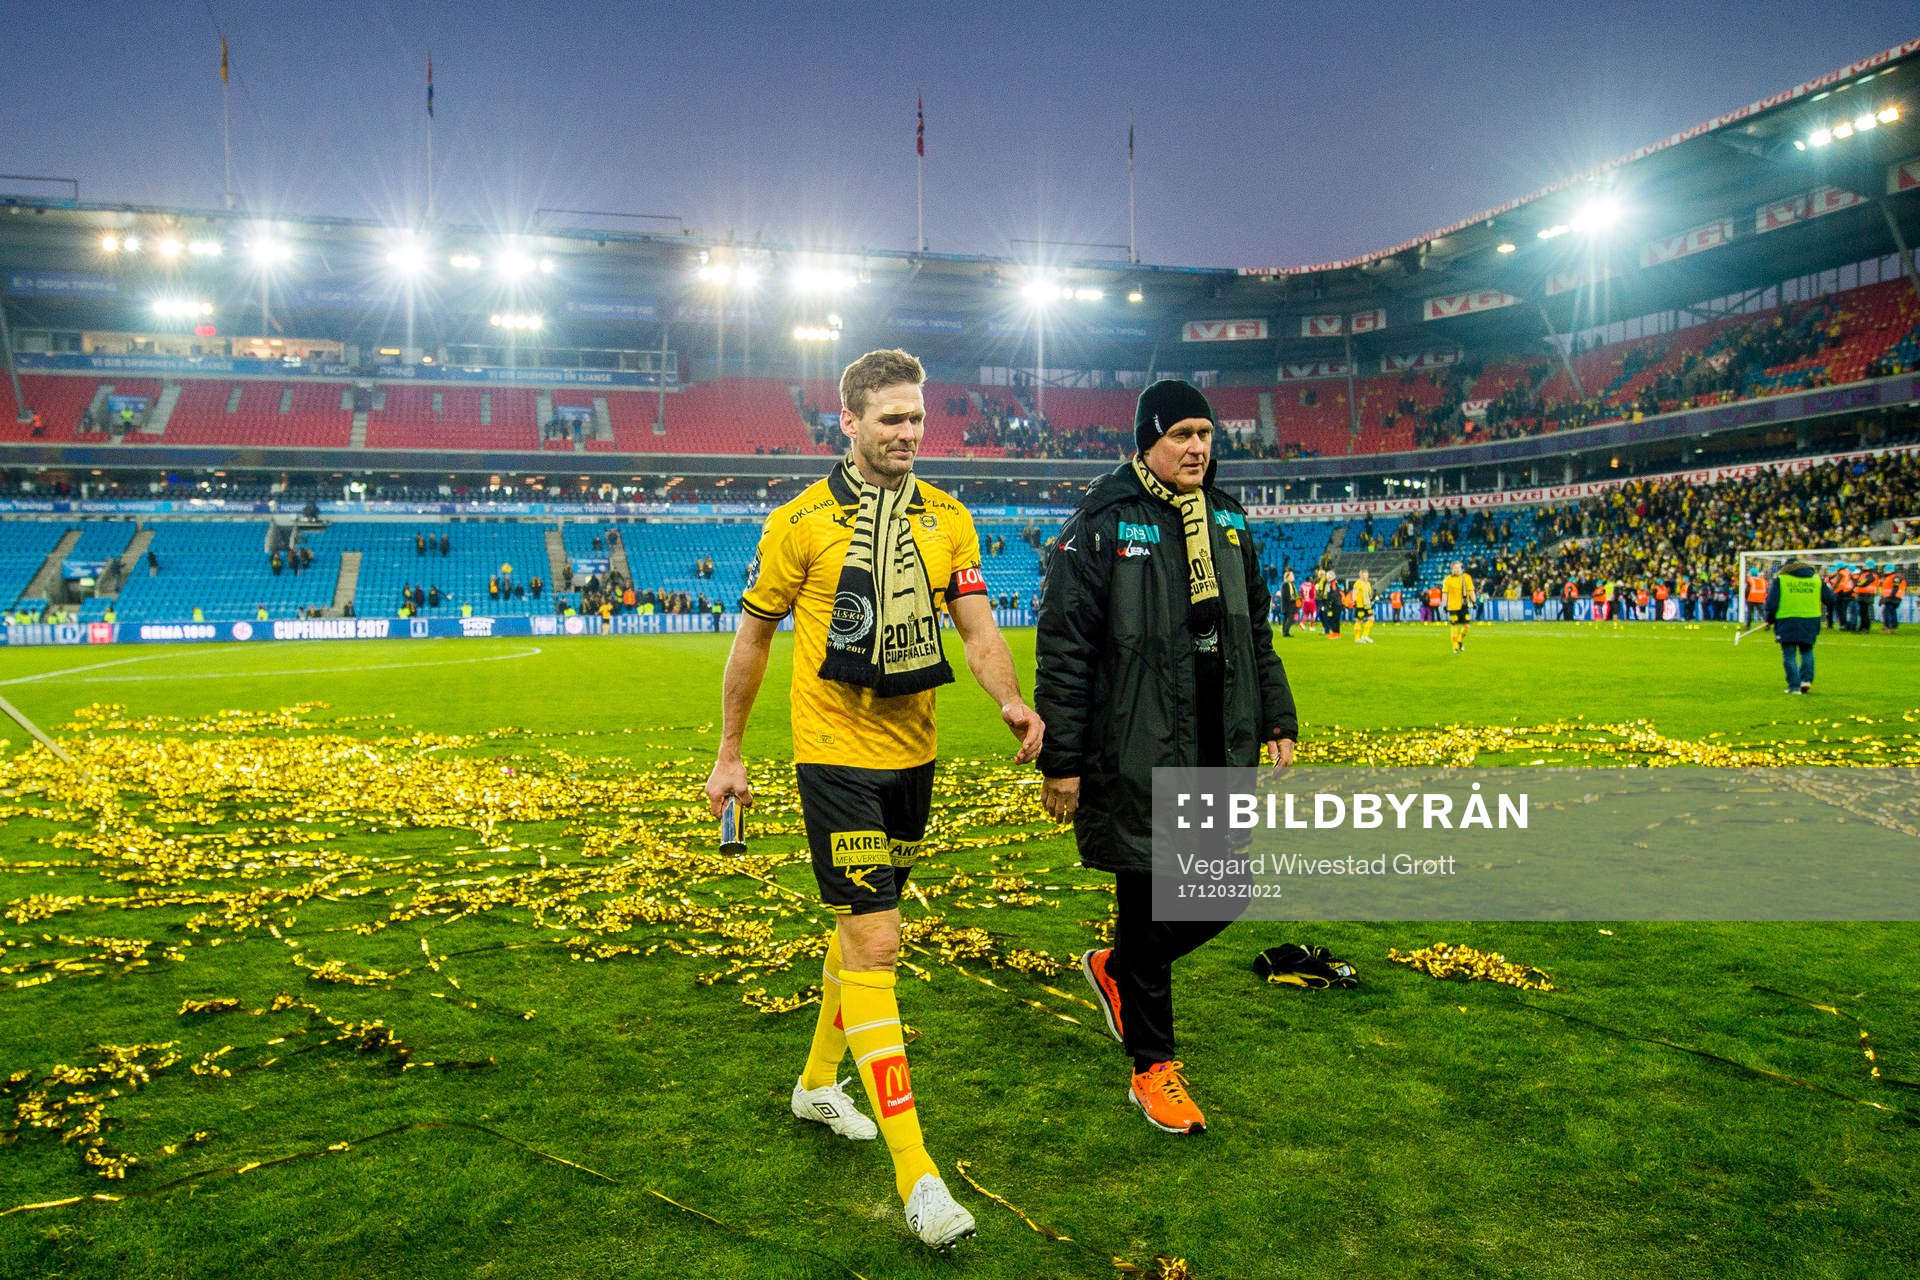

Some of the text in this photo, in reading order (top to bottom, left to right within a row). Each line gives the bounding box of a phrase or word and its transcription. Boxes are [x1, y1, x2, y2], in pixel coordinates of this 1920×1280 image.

[1850, 51, 1889, 75] VG
[1803, 71, 1840, 94] VG
[1758, 89, 1793, 111] VG
[1718, 105, 1750, 126] VG
[1680, 122, 1710, 142] VG
[1766, 187, 1862, 230] VG
[1648, 223, 1725, 264] VG
[1431, 293, 1505, 318] VG
[1191, 320, 1259, 339] VG
[1309, 312, 1379, 335] VG
[1283, 363, 1347, 380] VG
[1385, 352, 1456, 372] VG
[1256, 506, 1290, 517] VG
[1297, 504, 1333, 515] VG
[1341, 502, 1376, 514] VG
[1384, 499, 1421, 511] VG
[1427, 496, 1463, 509] VG
[1470, 493, 1504, 506] VG
[1509, 490, 1543, 503] VG
[1550, 485, 1581, 500] VG
[1770, 459, 1812, 475] VG
[789, 499, 835, 524] ØKLAND
[1026, 507, 1049, 515] NORSK
[273, 620, 389, 639] CUPFINALEN 2017
[884, 616, 934, 650] 2017
[846, 644, 867, 655] 2017
